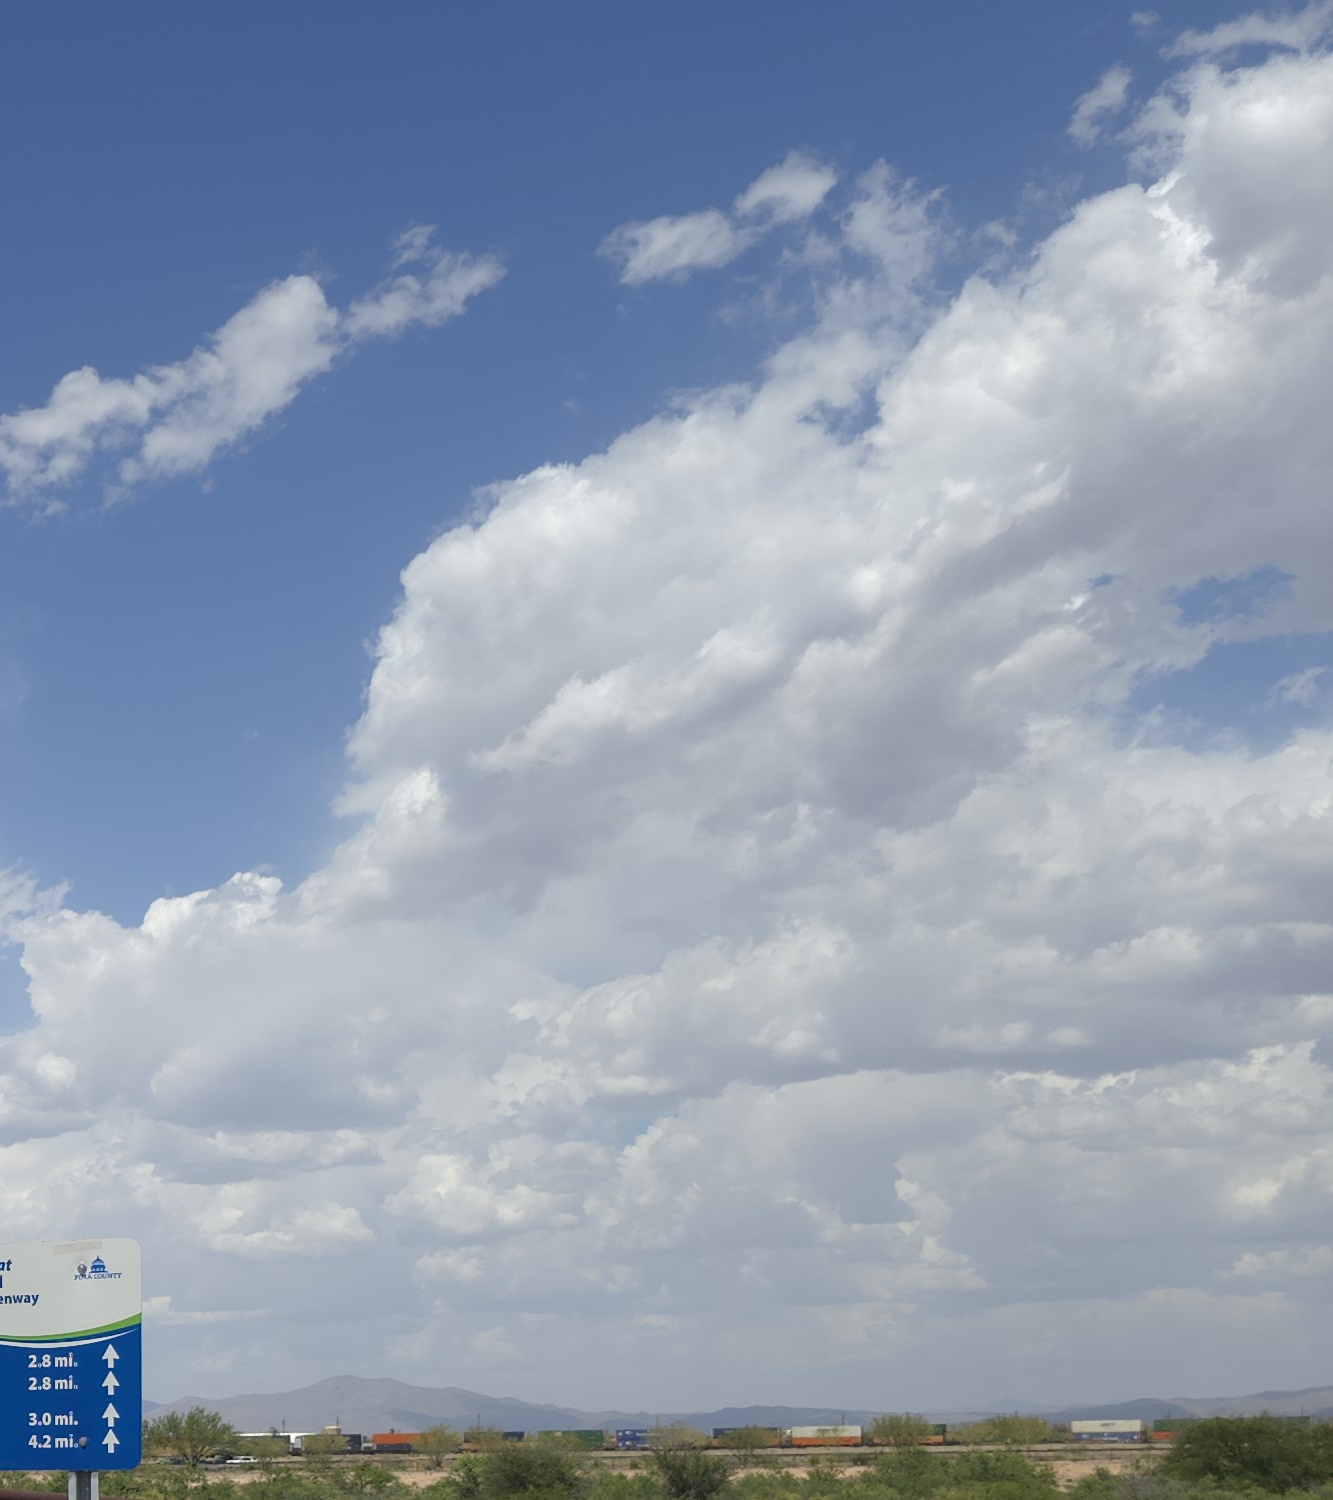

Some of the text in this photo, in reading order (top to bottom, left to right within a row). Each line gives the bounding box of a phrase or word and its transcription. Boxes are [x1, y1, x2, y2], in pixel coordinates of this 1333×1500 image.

[93, 1272, 122, 1280] COUNTY
[27, 1354, 52, 1369] 2.8
[54, 1352, 78, 1368] mi.
[27, 1377, 52, 1391] 2.8
[54, 1374, 78, 1390] mi.
[28, 1412, 52, 1426] 3.0
[54, 1410, 79, 1426] mi.
[27, 1434, 52, 1449] 4.2
[54, 1433, 79, 1449] mi.
